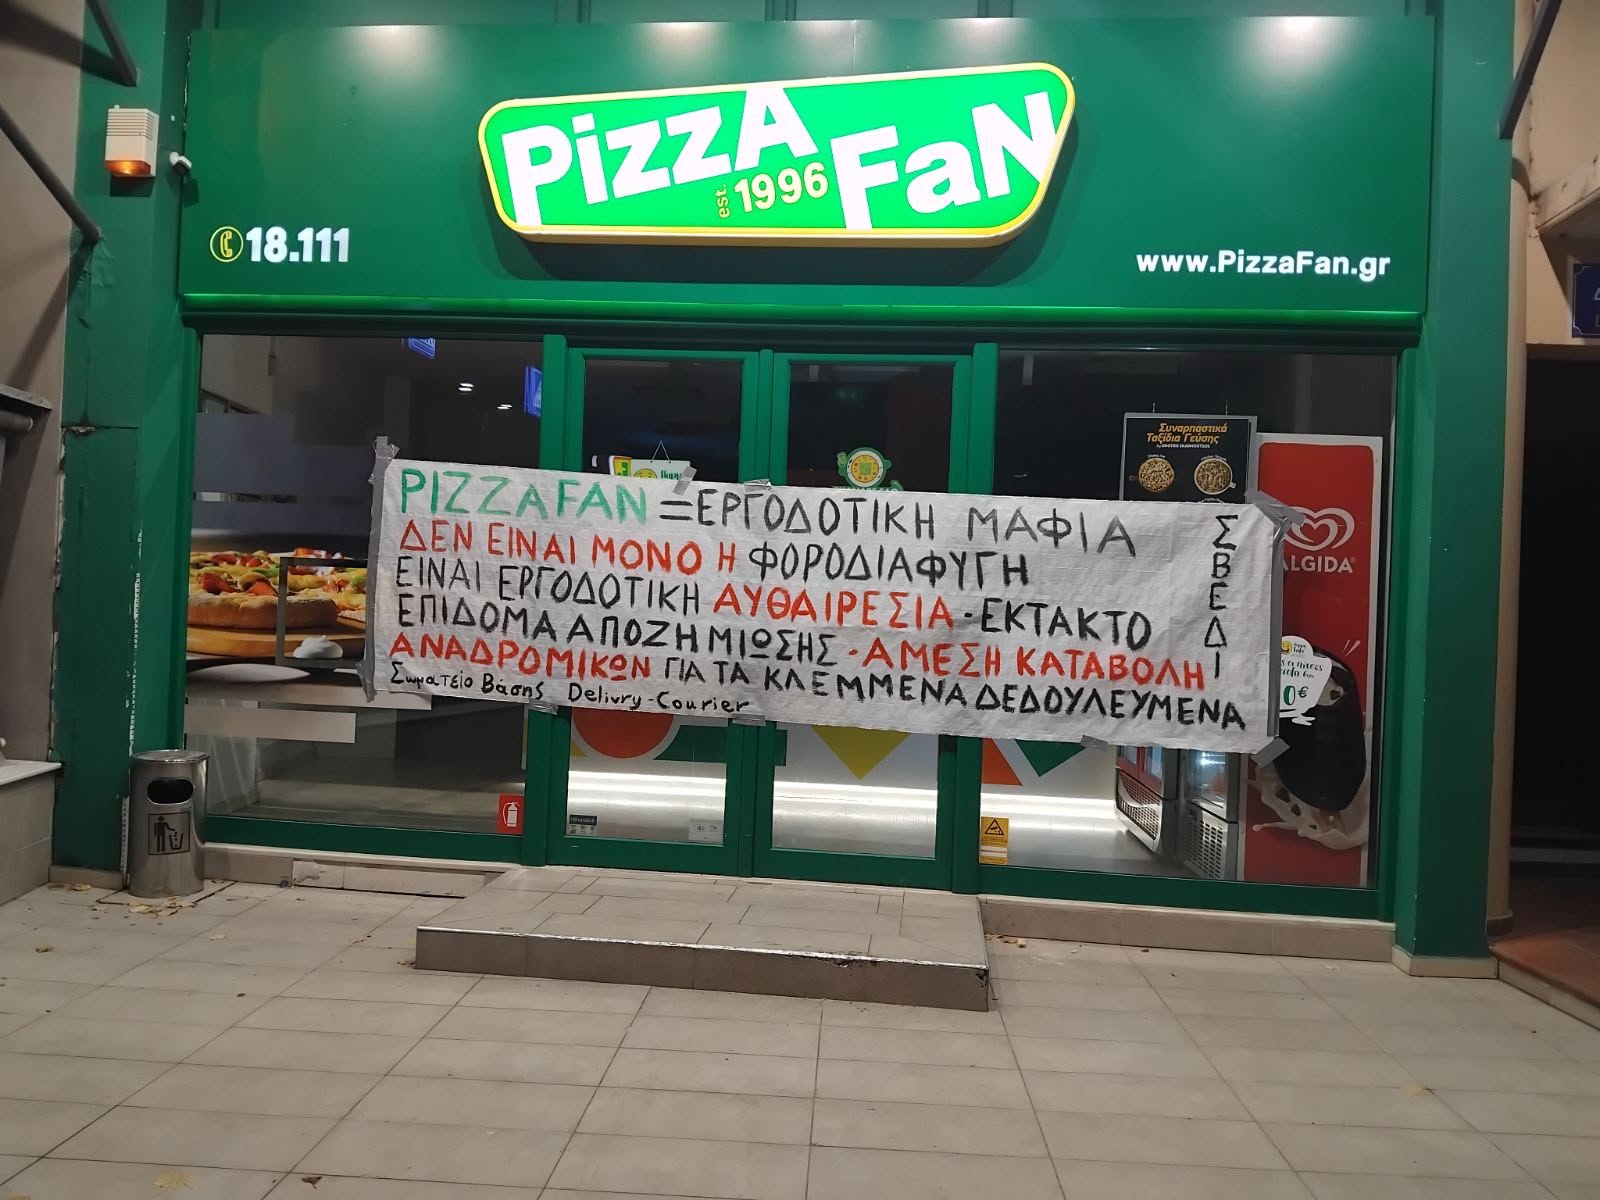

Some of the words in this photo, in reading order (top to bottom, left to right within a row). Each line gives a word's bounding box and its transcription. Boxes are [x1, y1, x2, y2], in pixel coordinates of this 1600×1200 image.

[714, 183, 730, 218] est.
[734, 161, 829, 213] 1996
[246, 226, 349, 262] 18.111
[1136, 249, 1391, 282] www.PizzaFan.gr
[1147, 433, 1180, 444] Ταξίδια
[1184, 433, 1220, 444] Γεύσης
[1158, 423, 1227, 434] Συναρπαστικά
[400, 519, 472, 552] ΔΕΝ
[488, 522, 576, 566] ΕΙΝΑΙ
[592, 534, 702, 575] ΜΟΝΟ
[718, 541, 736, 573] Η
[749, 541, 1029, 591] ΦΟΡΟΔΙΑΦΥΓΗ
[967, 506, 1137, 558] ΜΑΦΙΑ
[396, 556, 480, 593] ΕΙΝΑΙ
[499, 565, 699, 616] ΕΡΓΟΔΟΤΙΚΗ
[713, 582, 954, 631] ΑΥΘΑΙΡΕΣΙΑ
[398, 593, 557, 642] ΕΠΙΔΟΜΑ
[566, 614, 838, 666] ΑΠΟΖΗΜΙΩΣΗΣ
[1016, 646, 1205, 692] ΚΑΤΑΒΟΛΗ
[389, 631, 650, 682] ΑΝΑΔΡΟΜΙΚΩΝ
[665, 656, 706, 685] ΓΙΑ
[713, 660, 750, 686] ΤΑ
[764, 665, 968, 706] ΚΛΕΜΜΕΝΑ
[975, 683, 1246, 731] ΔΕΔΟΥΛΕΥΜΕΝΑ
